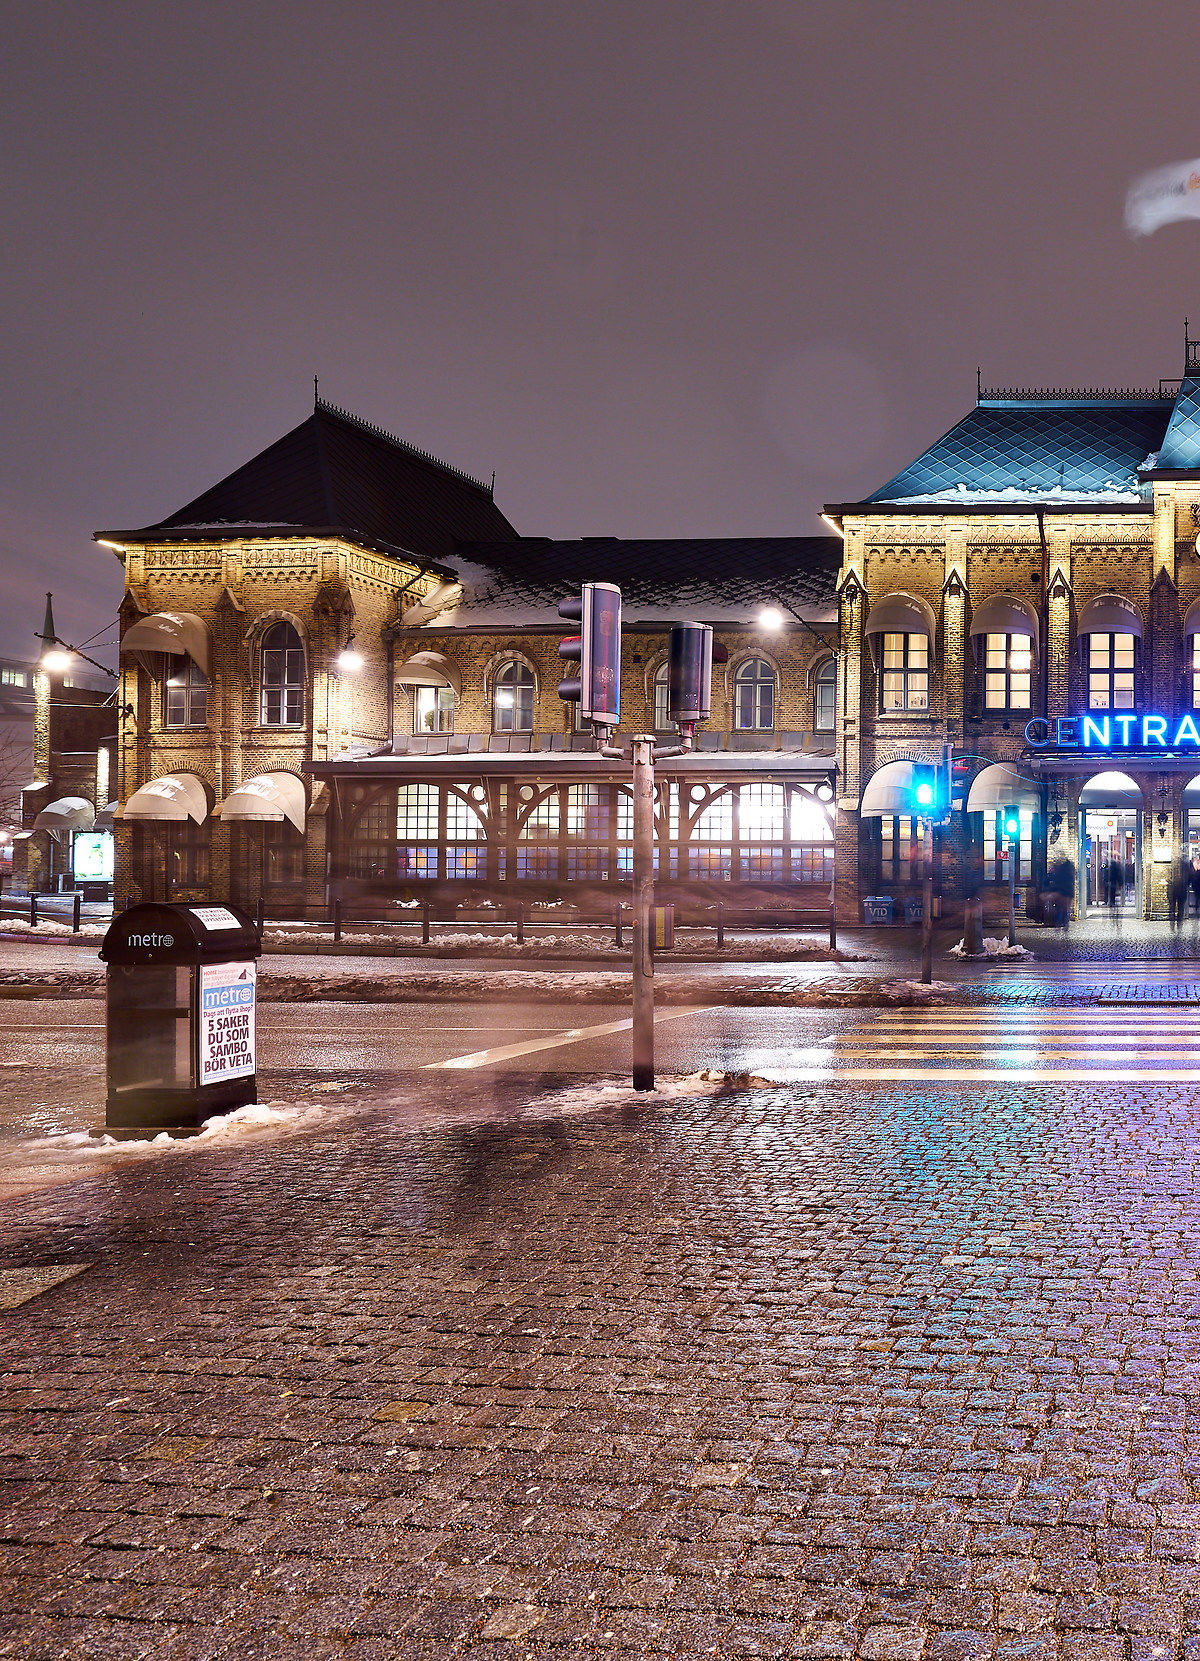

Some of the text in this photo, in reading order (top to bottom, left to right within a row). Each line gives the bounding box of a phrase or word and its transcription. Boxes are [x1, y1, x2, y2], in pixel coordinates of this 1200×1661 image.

[128, 933, 174, 947] metro
[205, 987, 252, 1007] metro
[208, 1014, 249, 1032] 5 SAKER
[208, 1027, 249, 1045] DU SOM
[209, 1040, 248, 1059] SAMBO
[204, 1052, 253, 1073] BÖR VETA
